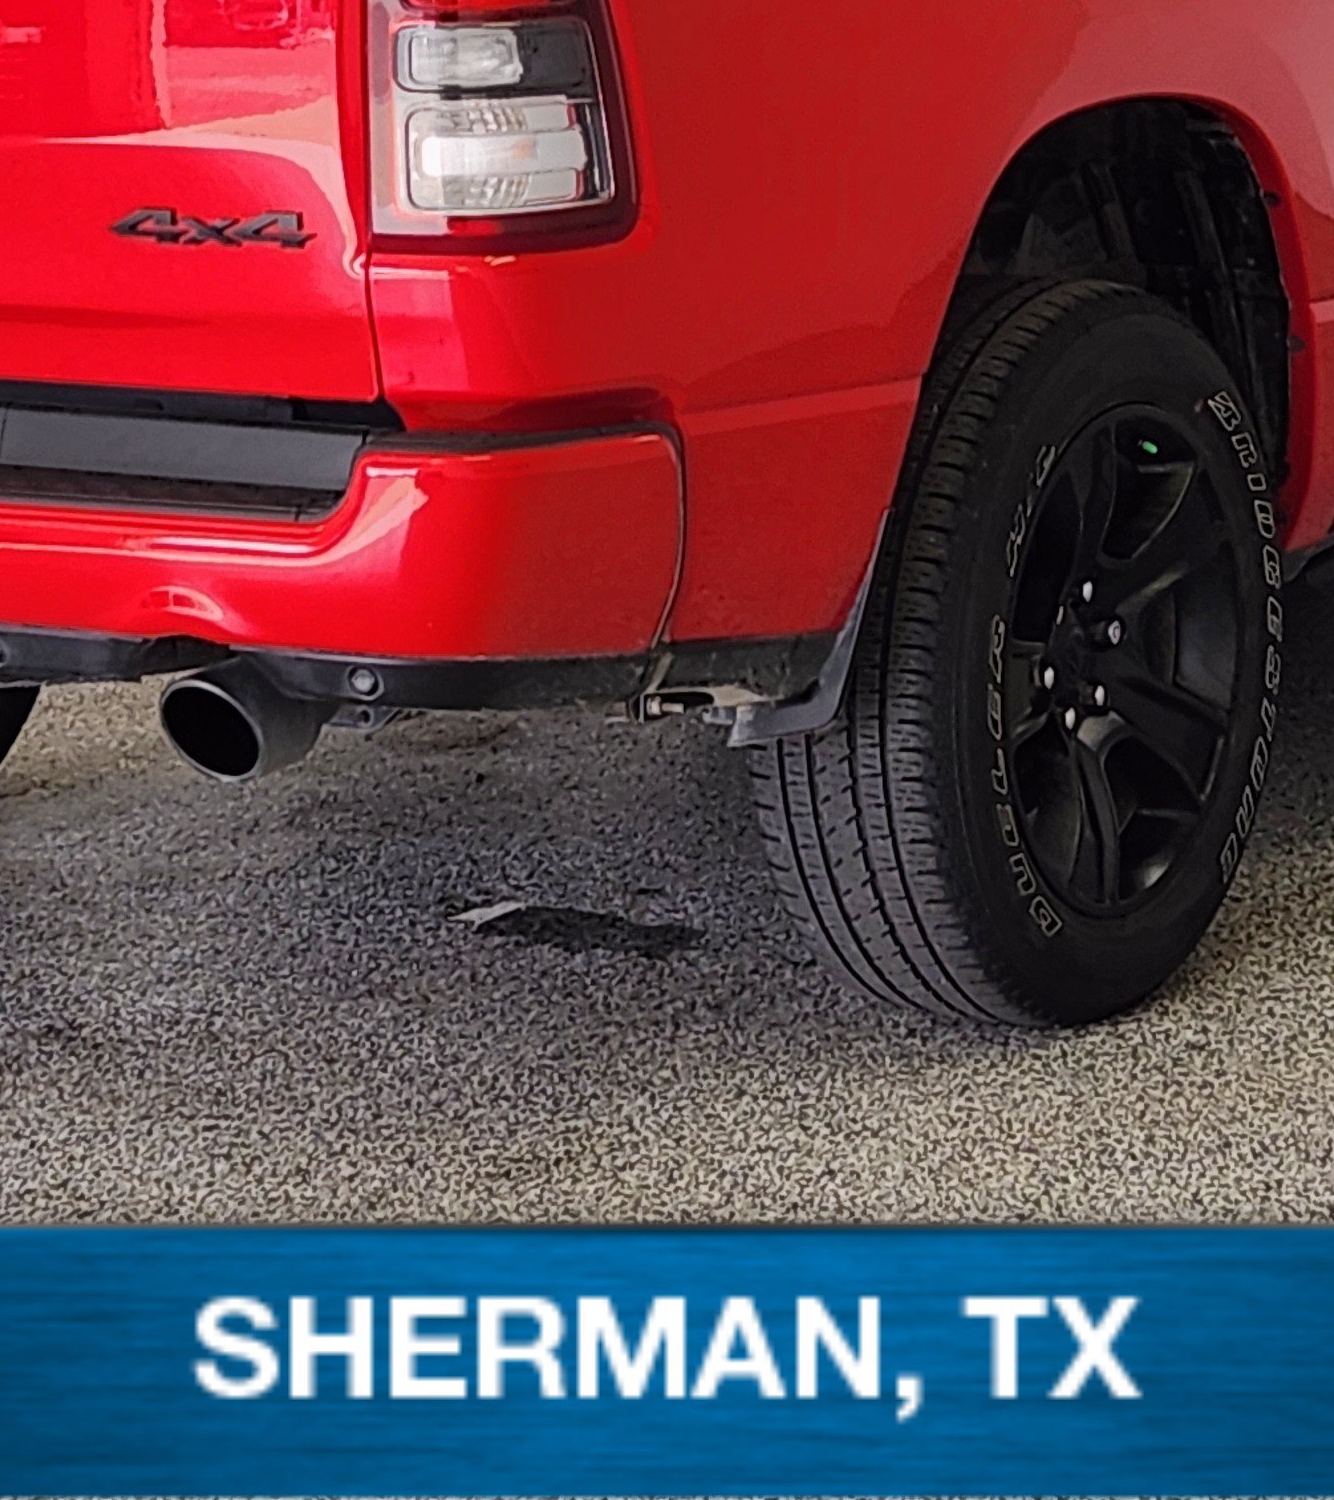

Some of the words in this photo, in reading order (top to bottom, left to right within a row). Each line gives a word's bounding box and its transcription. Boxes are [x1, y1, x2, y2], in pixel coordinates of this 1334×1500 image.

[109, 206, 317, 249] 4x4
[987, 614, 1063, 938] DUELER
[1207, 390, 1284, 885] BRIDGESTONE
